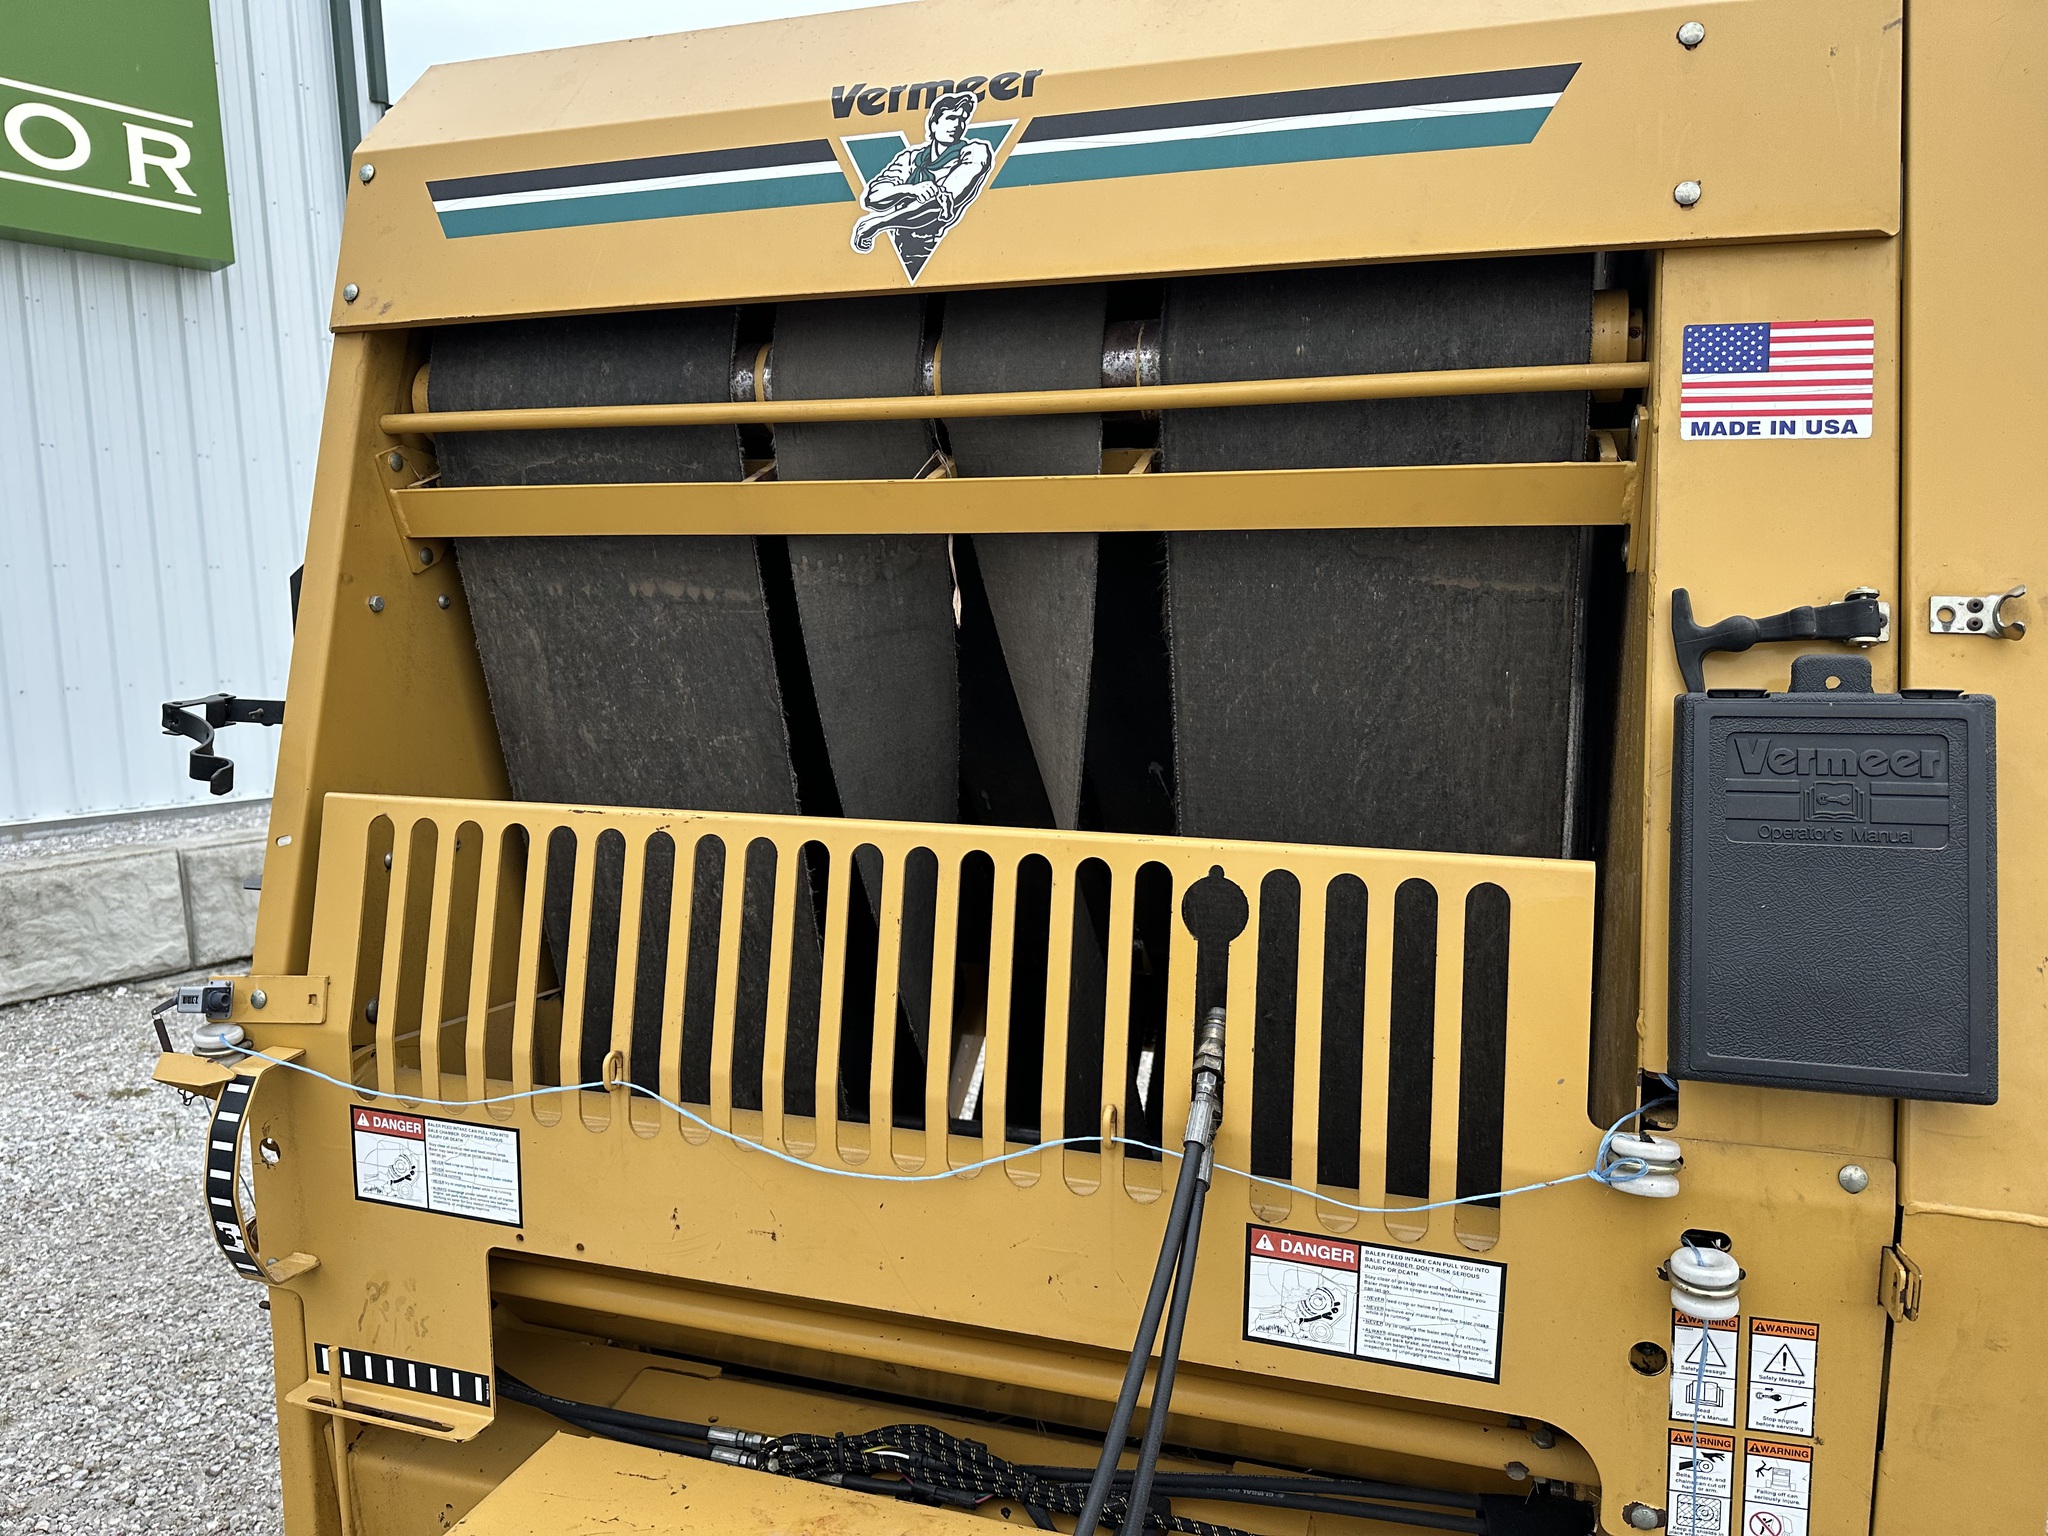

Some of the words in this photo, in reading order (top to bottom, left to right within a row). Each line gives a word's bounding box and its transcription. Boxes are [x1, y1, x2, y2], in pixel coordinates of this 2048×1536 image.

[831, 69, 1043, 118] Vermeer
[1691, 421, 1761, 436] MADE
[1770, 420, 1796, 435] IN
[1806, 420, 1858, 435] USA
[1734, 738, 1941, 778] Vermeer
[1758, 825, 1844, 843] Operator's
[1852, 827, 1914, 844] Manual
[373, 1116, 422, 1135] DANGER
[1281, 1239, 1355, 1263] DANGER
[1364, 1264, 1386, 1272] INJURY
[1365, 1249, 1386, 1258] BALER
[1405, 1255, 1426, 1264] INTAKE
[1442, 1261, 1458, 1269] PULL
[1475, 1266, 1489, 1274] INTO
[1365, 1256, 1381, 1264] BALE
[1416, 1264, 1434, 1272] DON'T
[1436, 1267, 1451, 1275] RISK
[1452, 1270, 1480, 1280] SERIOUS
[1688, 1316, 1736, 1327] WANING
[1766, 1324, 1815, 1336] WARNING
[1759, 1374, 1777, 1382] Safety
[1779, 1377, 1805, 1385] Message
[1776, 1424, 1805, 1432] servicing.
[1684, 1434, 1731, 1448] WARNING
[1760, 1445, 1809, 1459] WARNING
[1754, 1495, 1780, 1503] seriously
[1756, 1489, 1776, 1497] Falling
